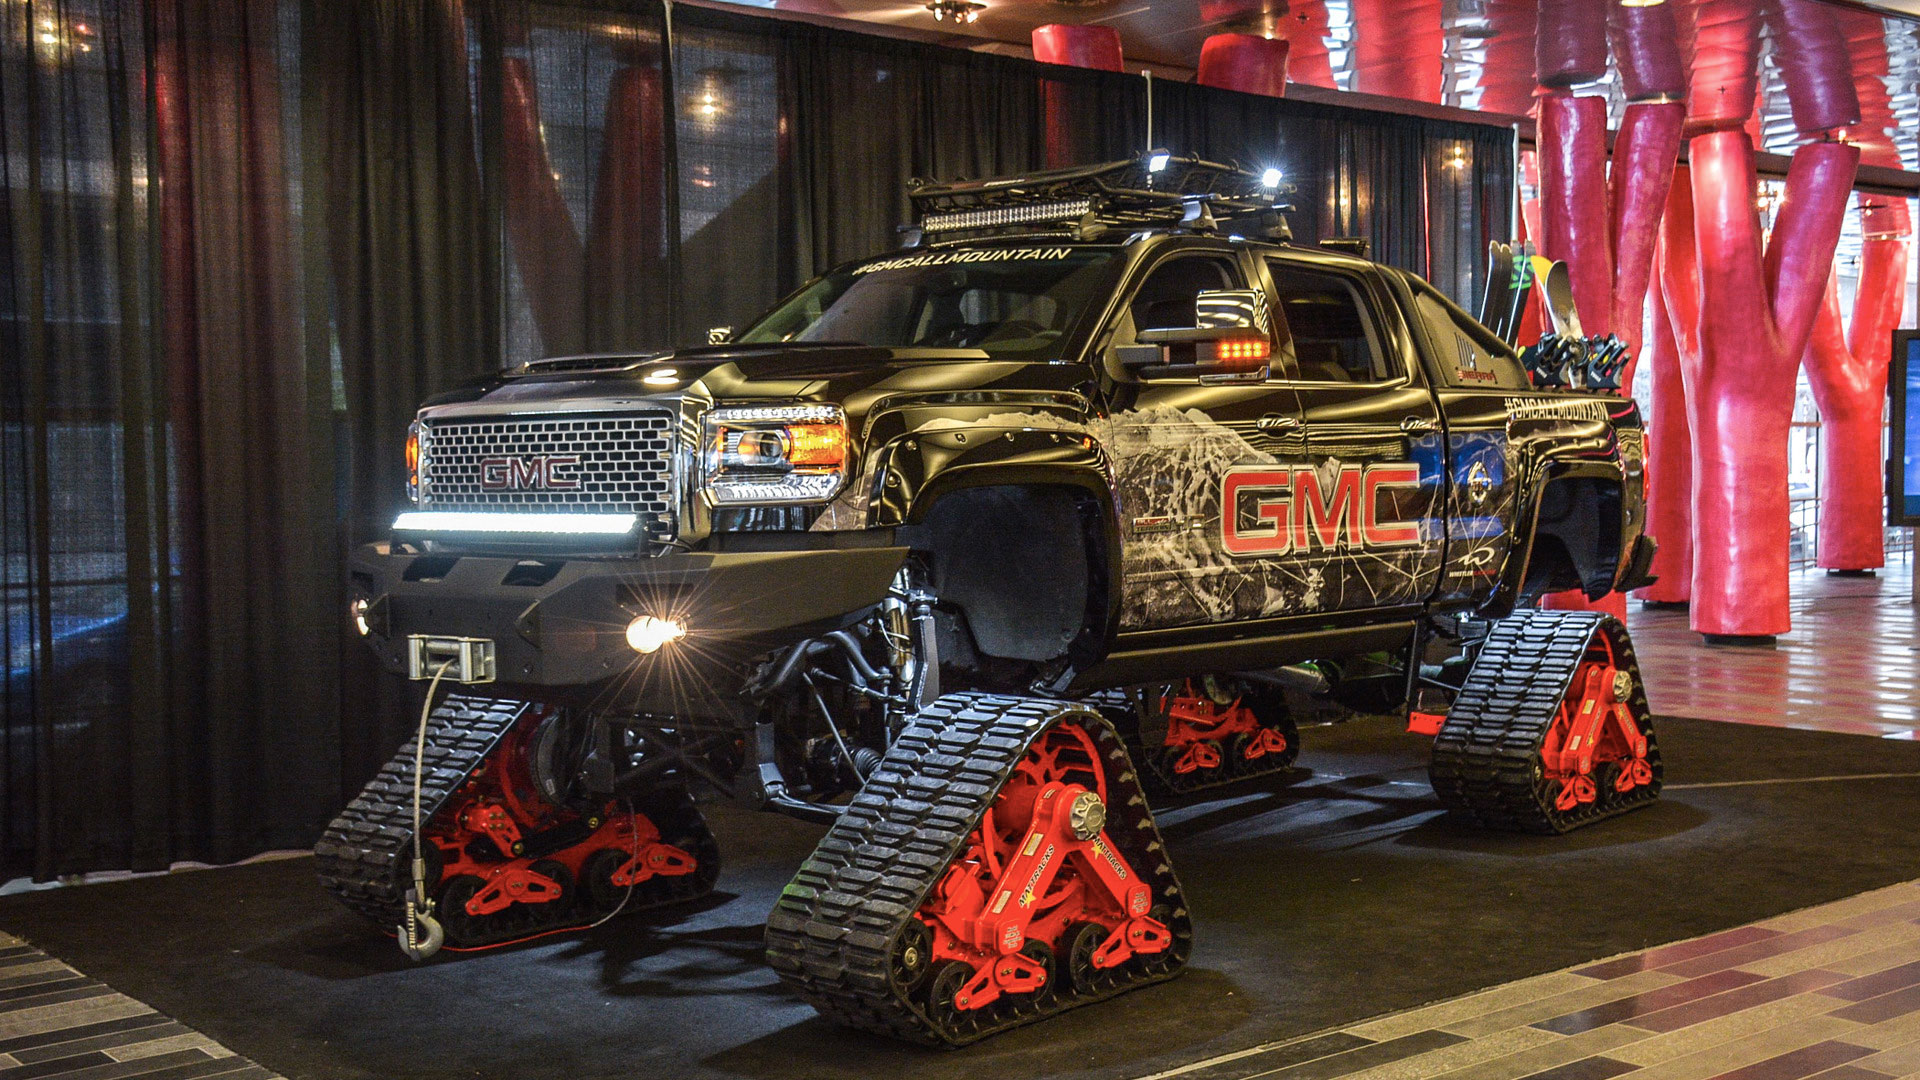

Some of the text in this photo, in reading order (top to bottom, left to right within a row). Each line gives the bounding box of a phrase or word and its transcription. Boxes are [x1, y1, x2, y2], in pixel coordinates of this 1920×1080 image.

[852, 248, 1072, 276] #GMCALLMOUNTAIN
[480, 455, 581, 490] GMC
[1221, 463, 1420, 556] GMC
[1018, 844, 1055, 908] MATTRACKS
[1091, 836, 1127, 880] MATTRACKS
